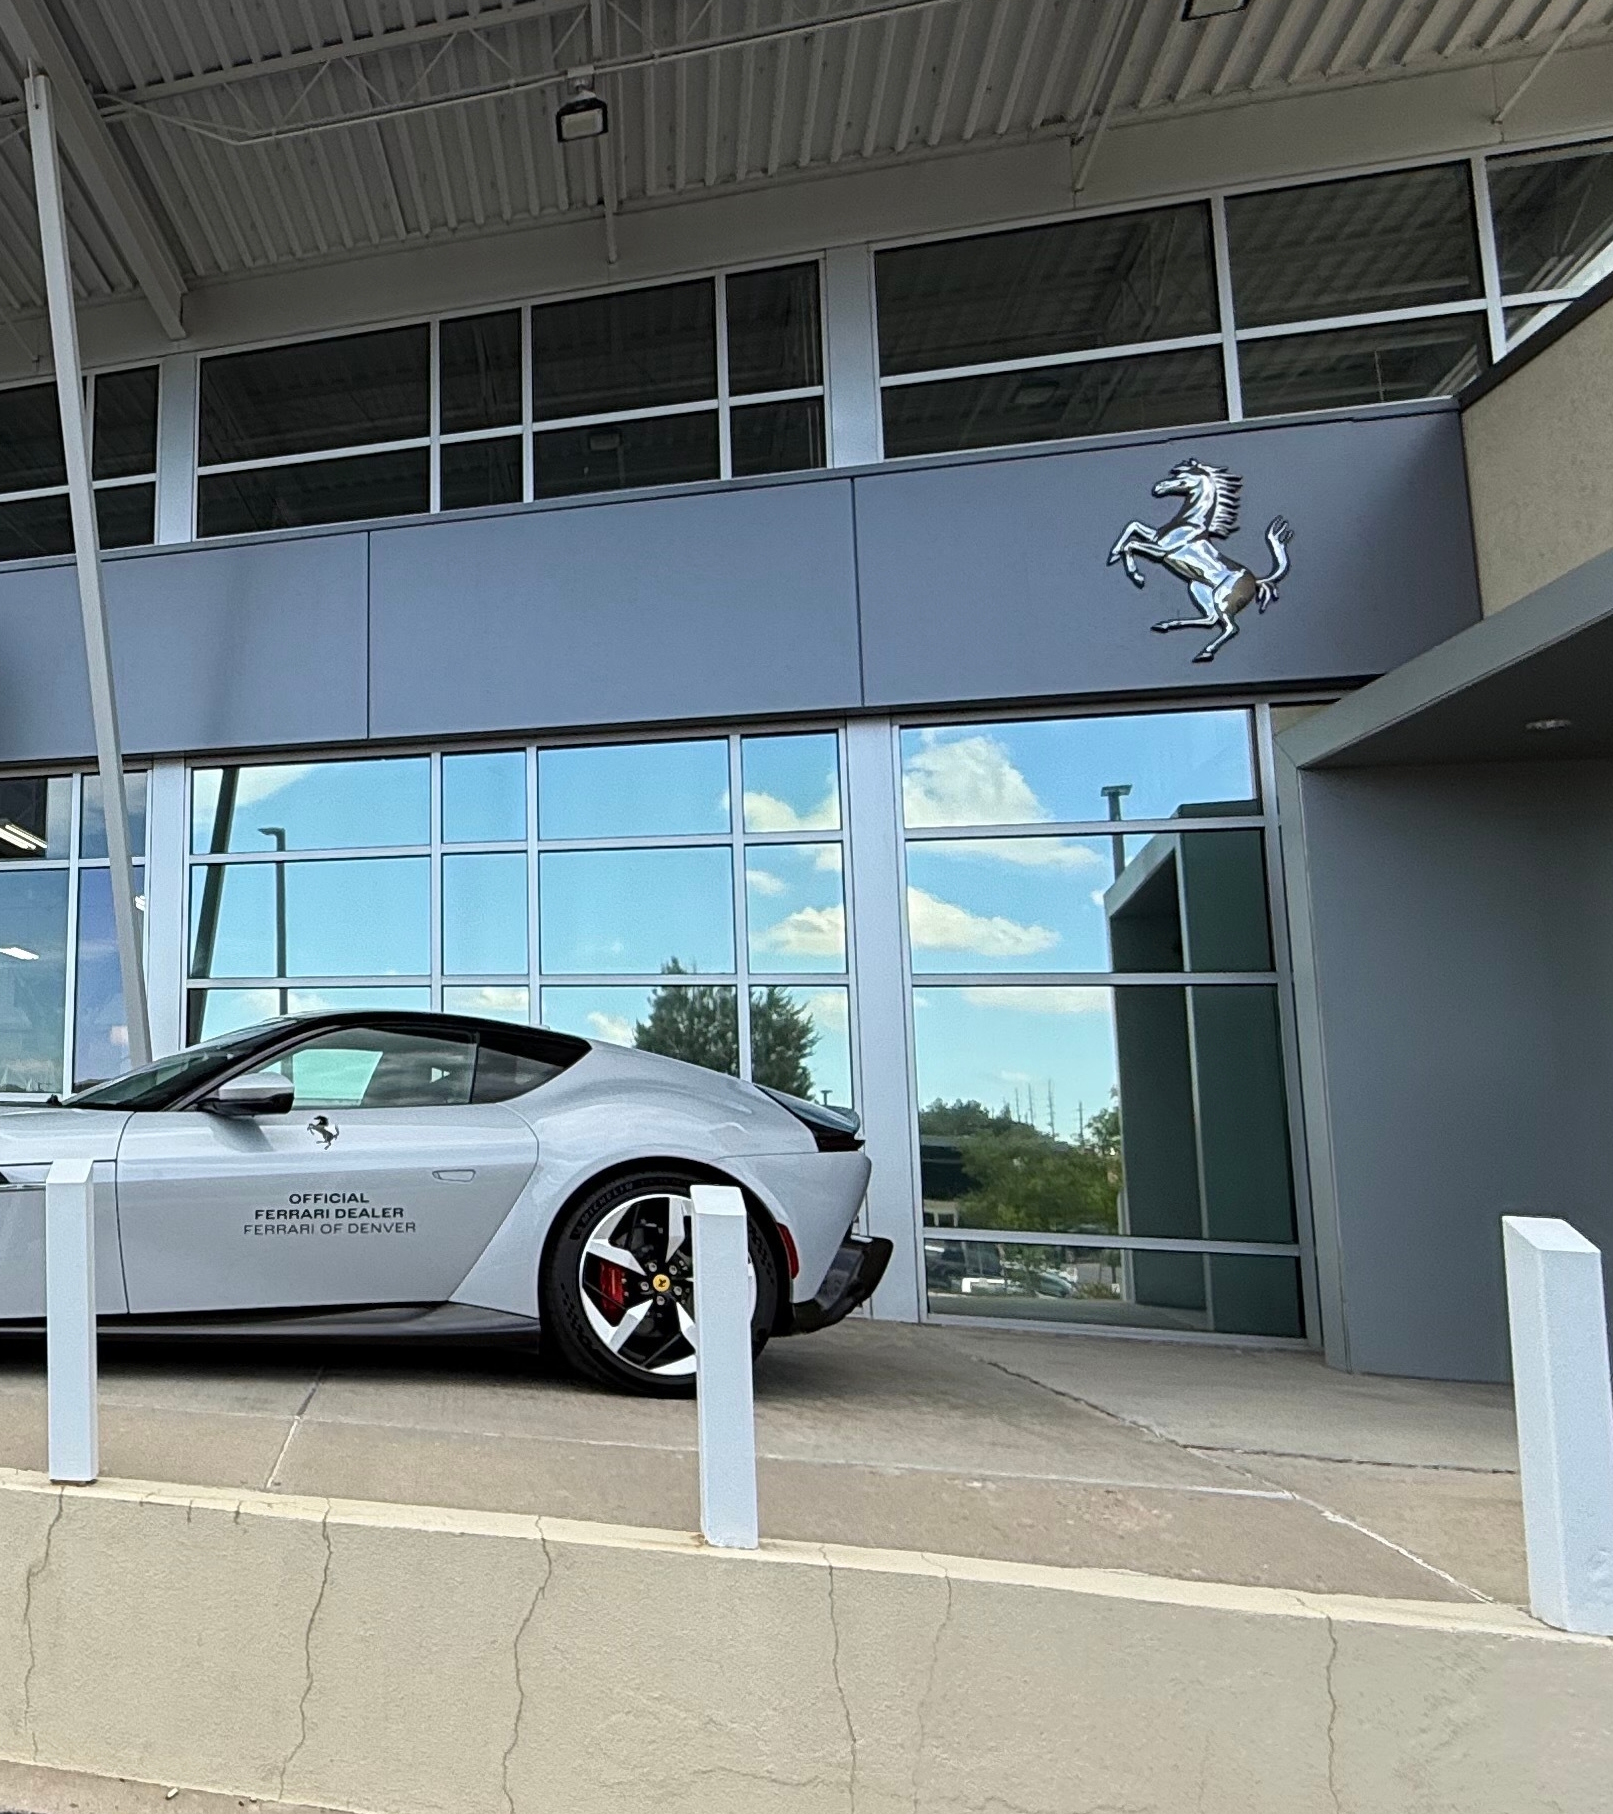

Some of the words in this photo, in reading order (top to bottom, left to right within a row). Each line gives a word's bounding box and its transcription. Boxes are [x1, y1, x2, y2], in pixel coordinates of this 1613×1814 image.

[288, 1193, 370, 1204] OFFICIAL
[255, 1209, 330, 1220] FERRARI
[335, 1207, 404, 1219] DEALER
[243, 1224, 315, 1236] FERRARI
[320, 1222, 342, 1234] OF
[347, 1221, 417, 1234] DENVER
